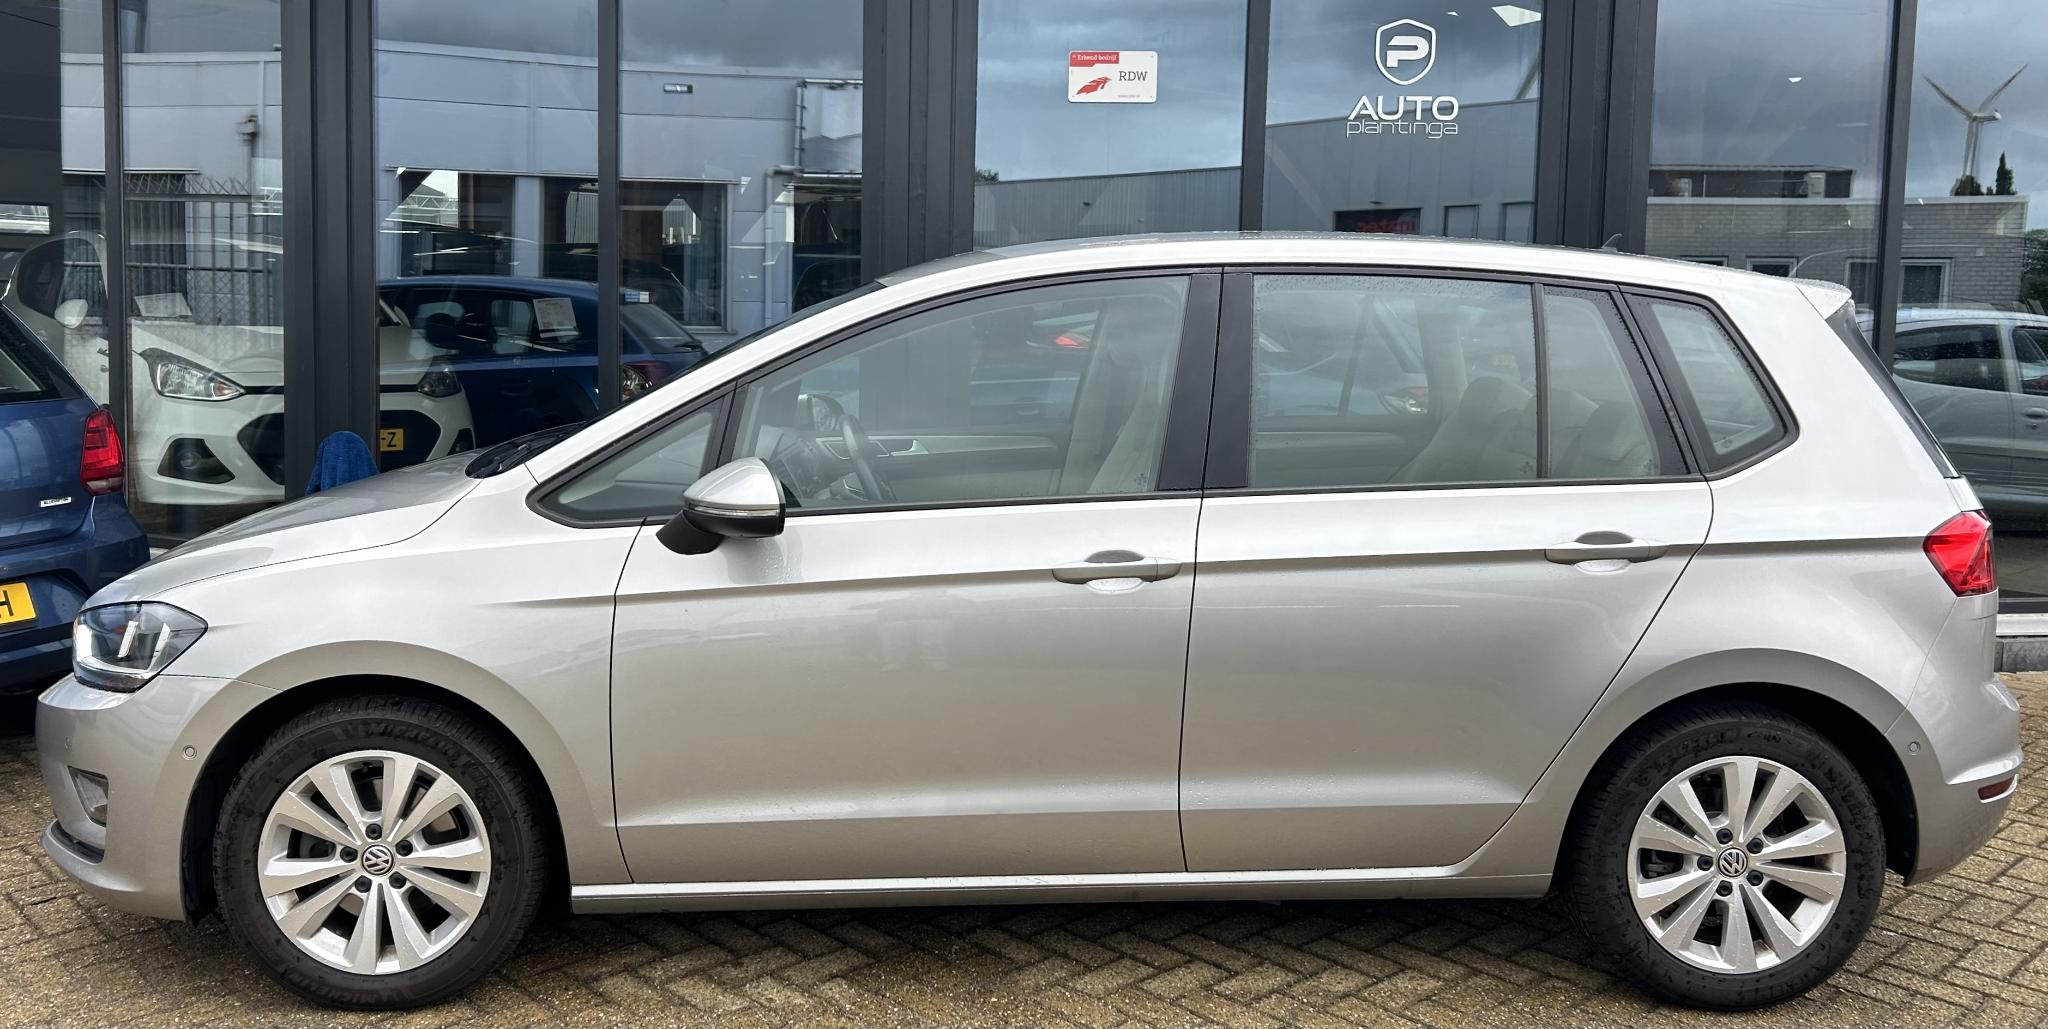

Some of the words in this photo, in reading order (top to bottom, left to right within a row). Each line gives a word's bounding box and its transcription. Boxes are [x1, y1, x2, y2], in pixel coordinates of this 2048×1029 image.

[1118, 70, 1148, 82] RDW
[1347, 95, 1459, 121] AUTO
[1346, 119, 1459, 139] plantinga
